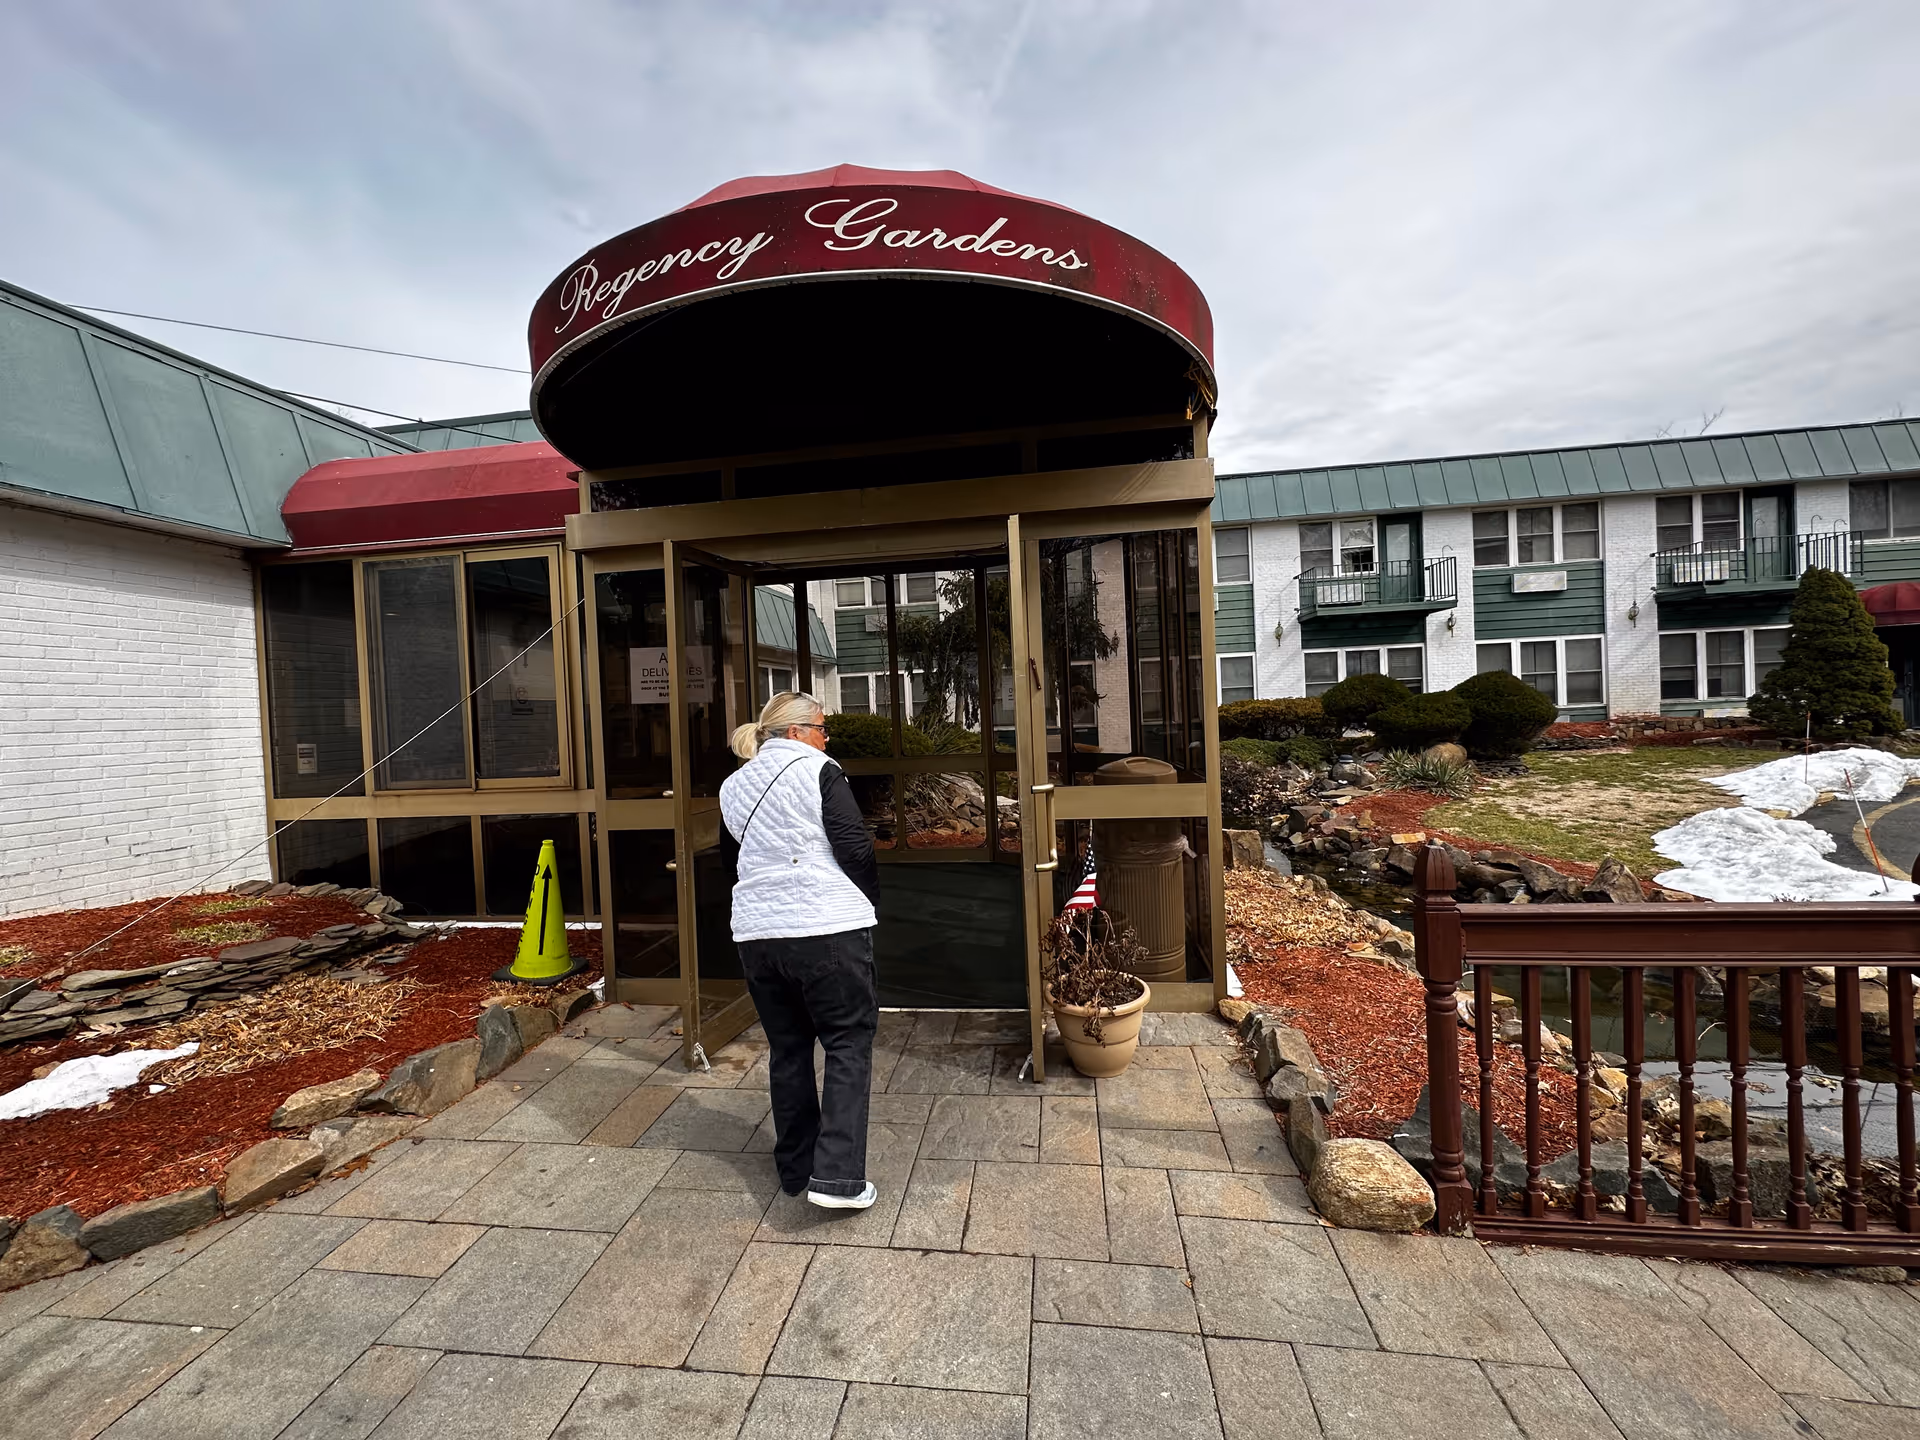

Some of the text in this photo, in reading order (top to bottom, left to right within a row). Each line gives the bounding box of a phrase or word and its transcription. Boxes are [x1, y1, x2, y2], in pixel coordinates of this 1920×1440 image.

[555, 197, 1088, 333] Regency Gardens
[642, 666, 703, 677] DELIVIES
